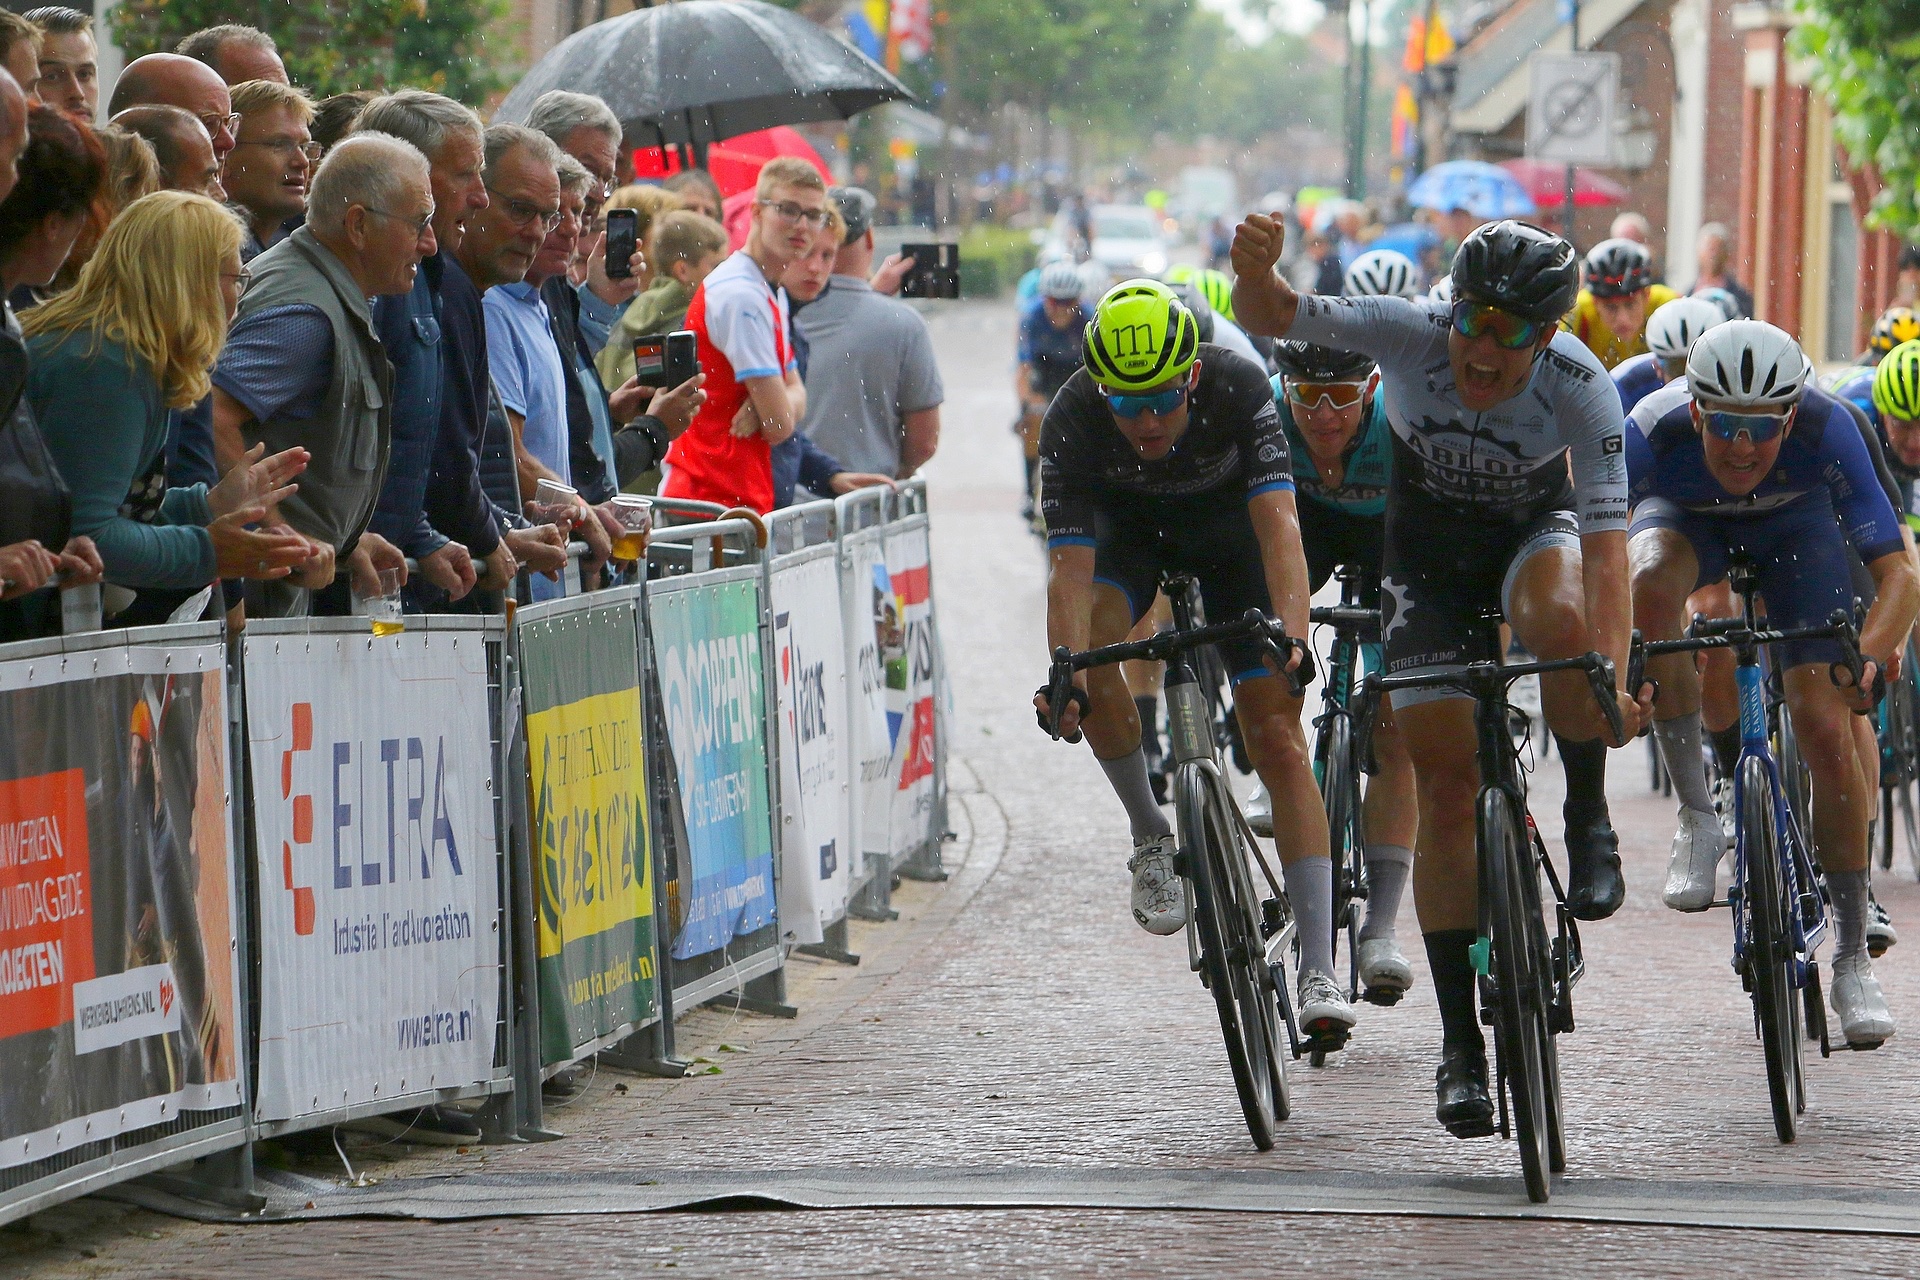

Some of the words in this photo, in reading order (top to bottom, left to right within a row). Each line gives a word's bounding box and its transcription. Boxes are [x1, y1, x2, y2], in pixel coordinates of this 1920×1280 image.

[1390, 653, 1427, 672] STREET
[1428, 651, 1457, 662] JUMP
[333, 736, 463, 888] ELTRA
